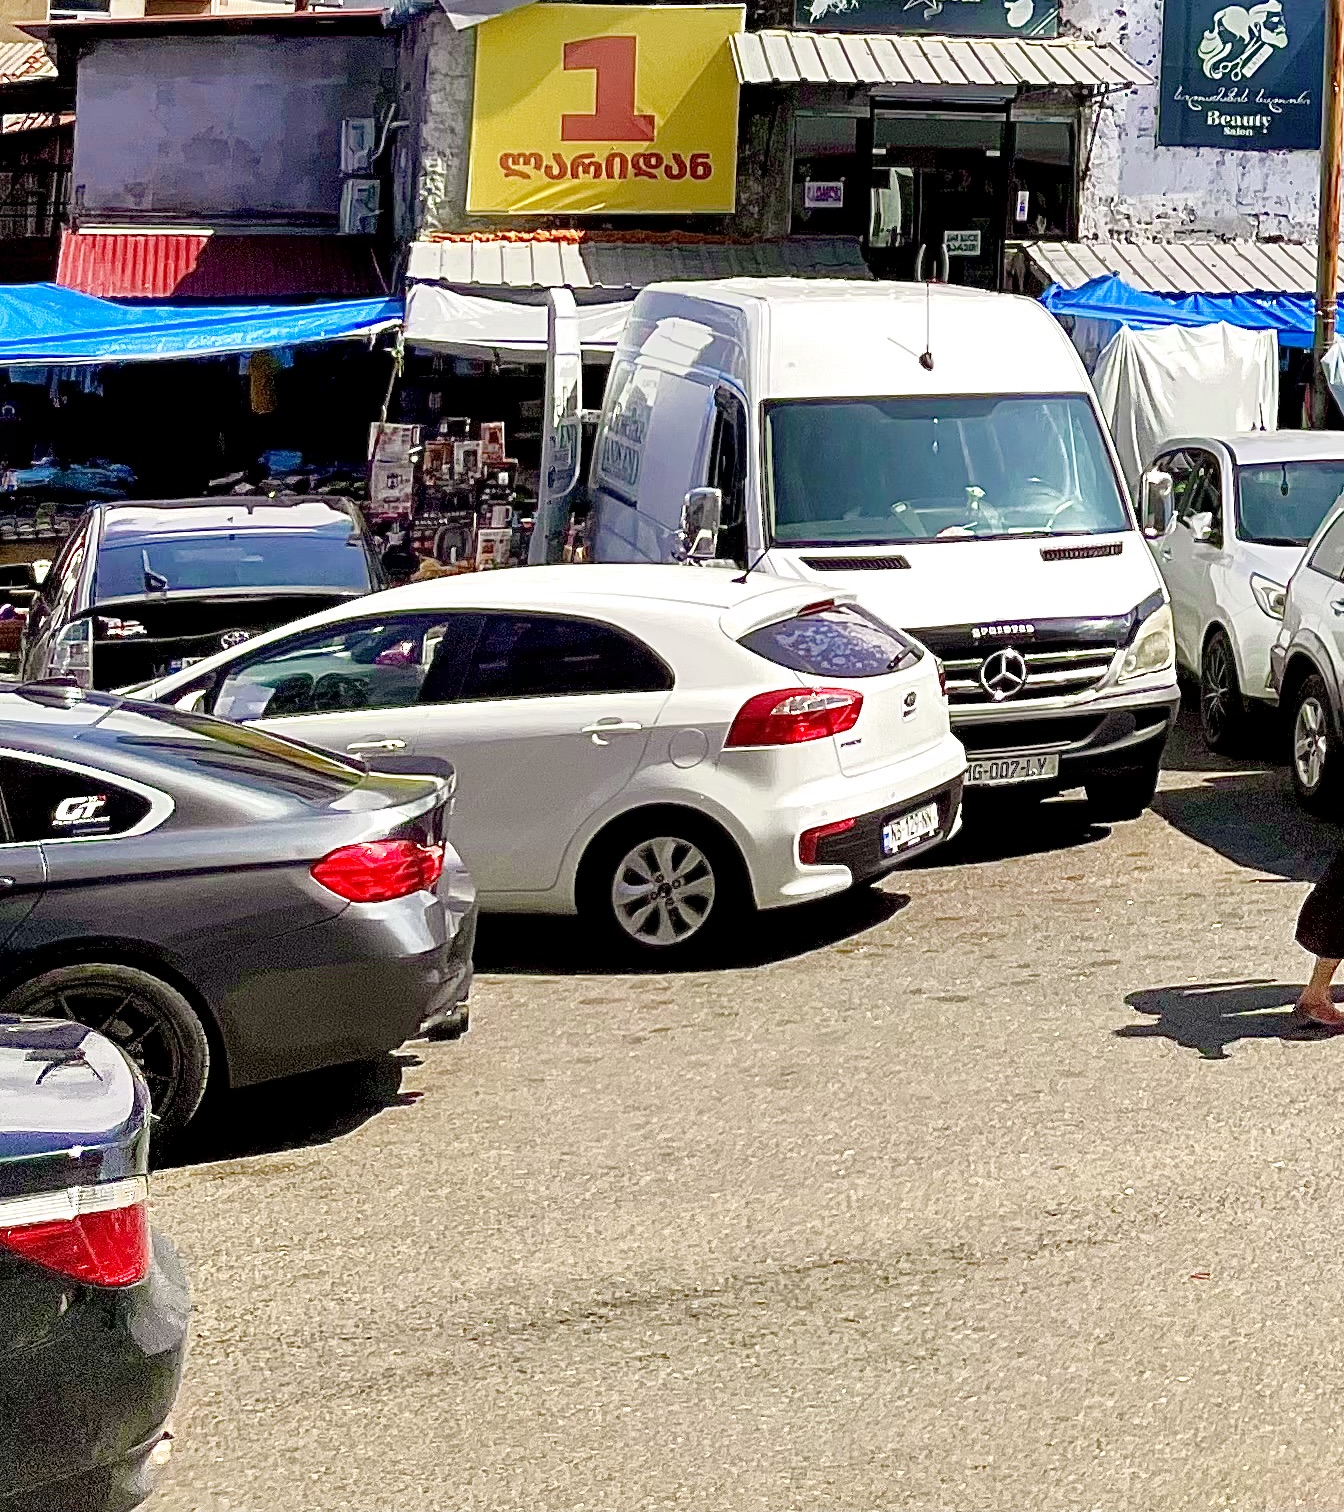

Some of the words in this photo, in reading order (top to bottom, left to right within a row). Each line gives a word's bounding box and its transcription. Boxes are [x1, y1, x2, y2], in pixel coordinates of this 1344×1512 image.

[560, 34, 656, 142] 1
[1206, 110, 1273, 133] Beauty
[1223, 126, 1254, 137] Salon
[498, 151, 713, 181] ლარიდან
